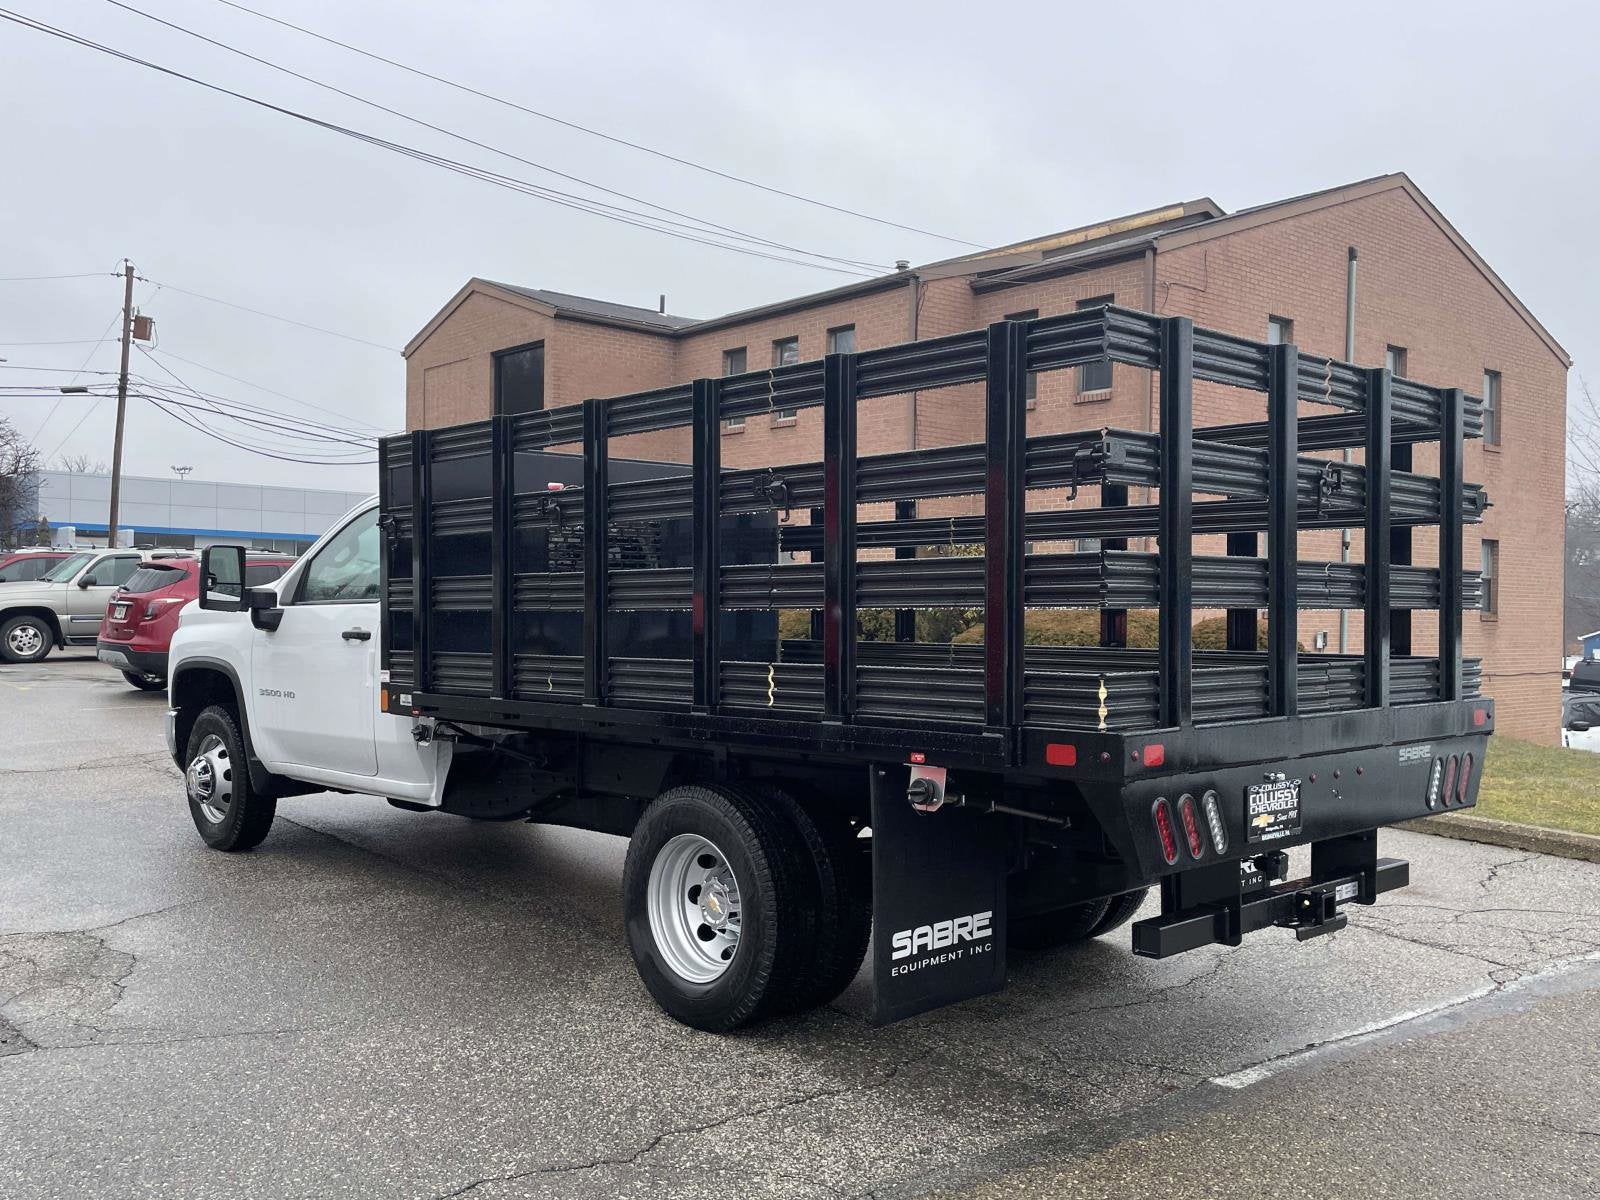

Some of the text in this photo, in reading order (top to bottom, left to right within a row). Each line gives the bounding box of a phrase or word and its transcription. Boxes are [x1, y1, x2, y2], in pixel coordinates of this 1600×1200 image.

[259, 689, 295, 699] 3500 HD
[1399, 745, 1431, 761] SABRE
[1261, 781, 1291, 792] COLUSSY
[1250, 788, 1298, 806] COLUSSY
[1250, 799, 1298, 815] CHEVROLET
[1249, 876, 1262, 885] INC
[892, 911, 992, 960] SABRE
[892, 943, 992, 977] EQUIPMENT INC
